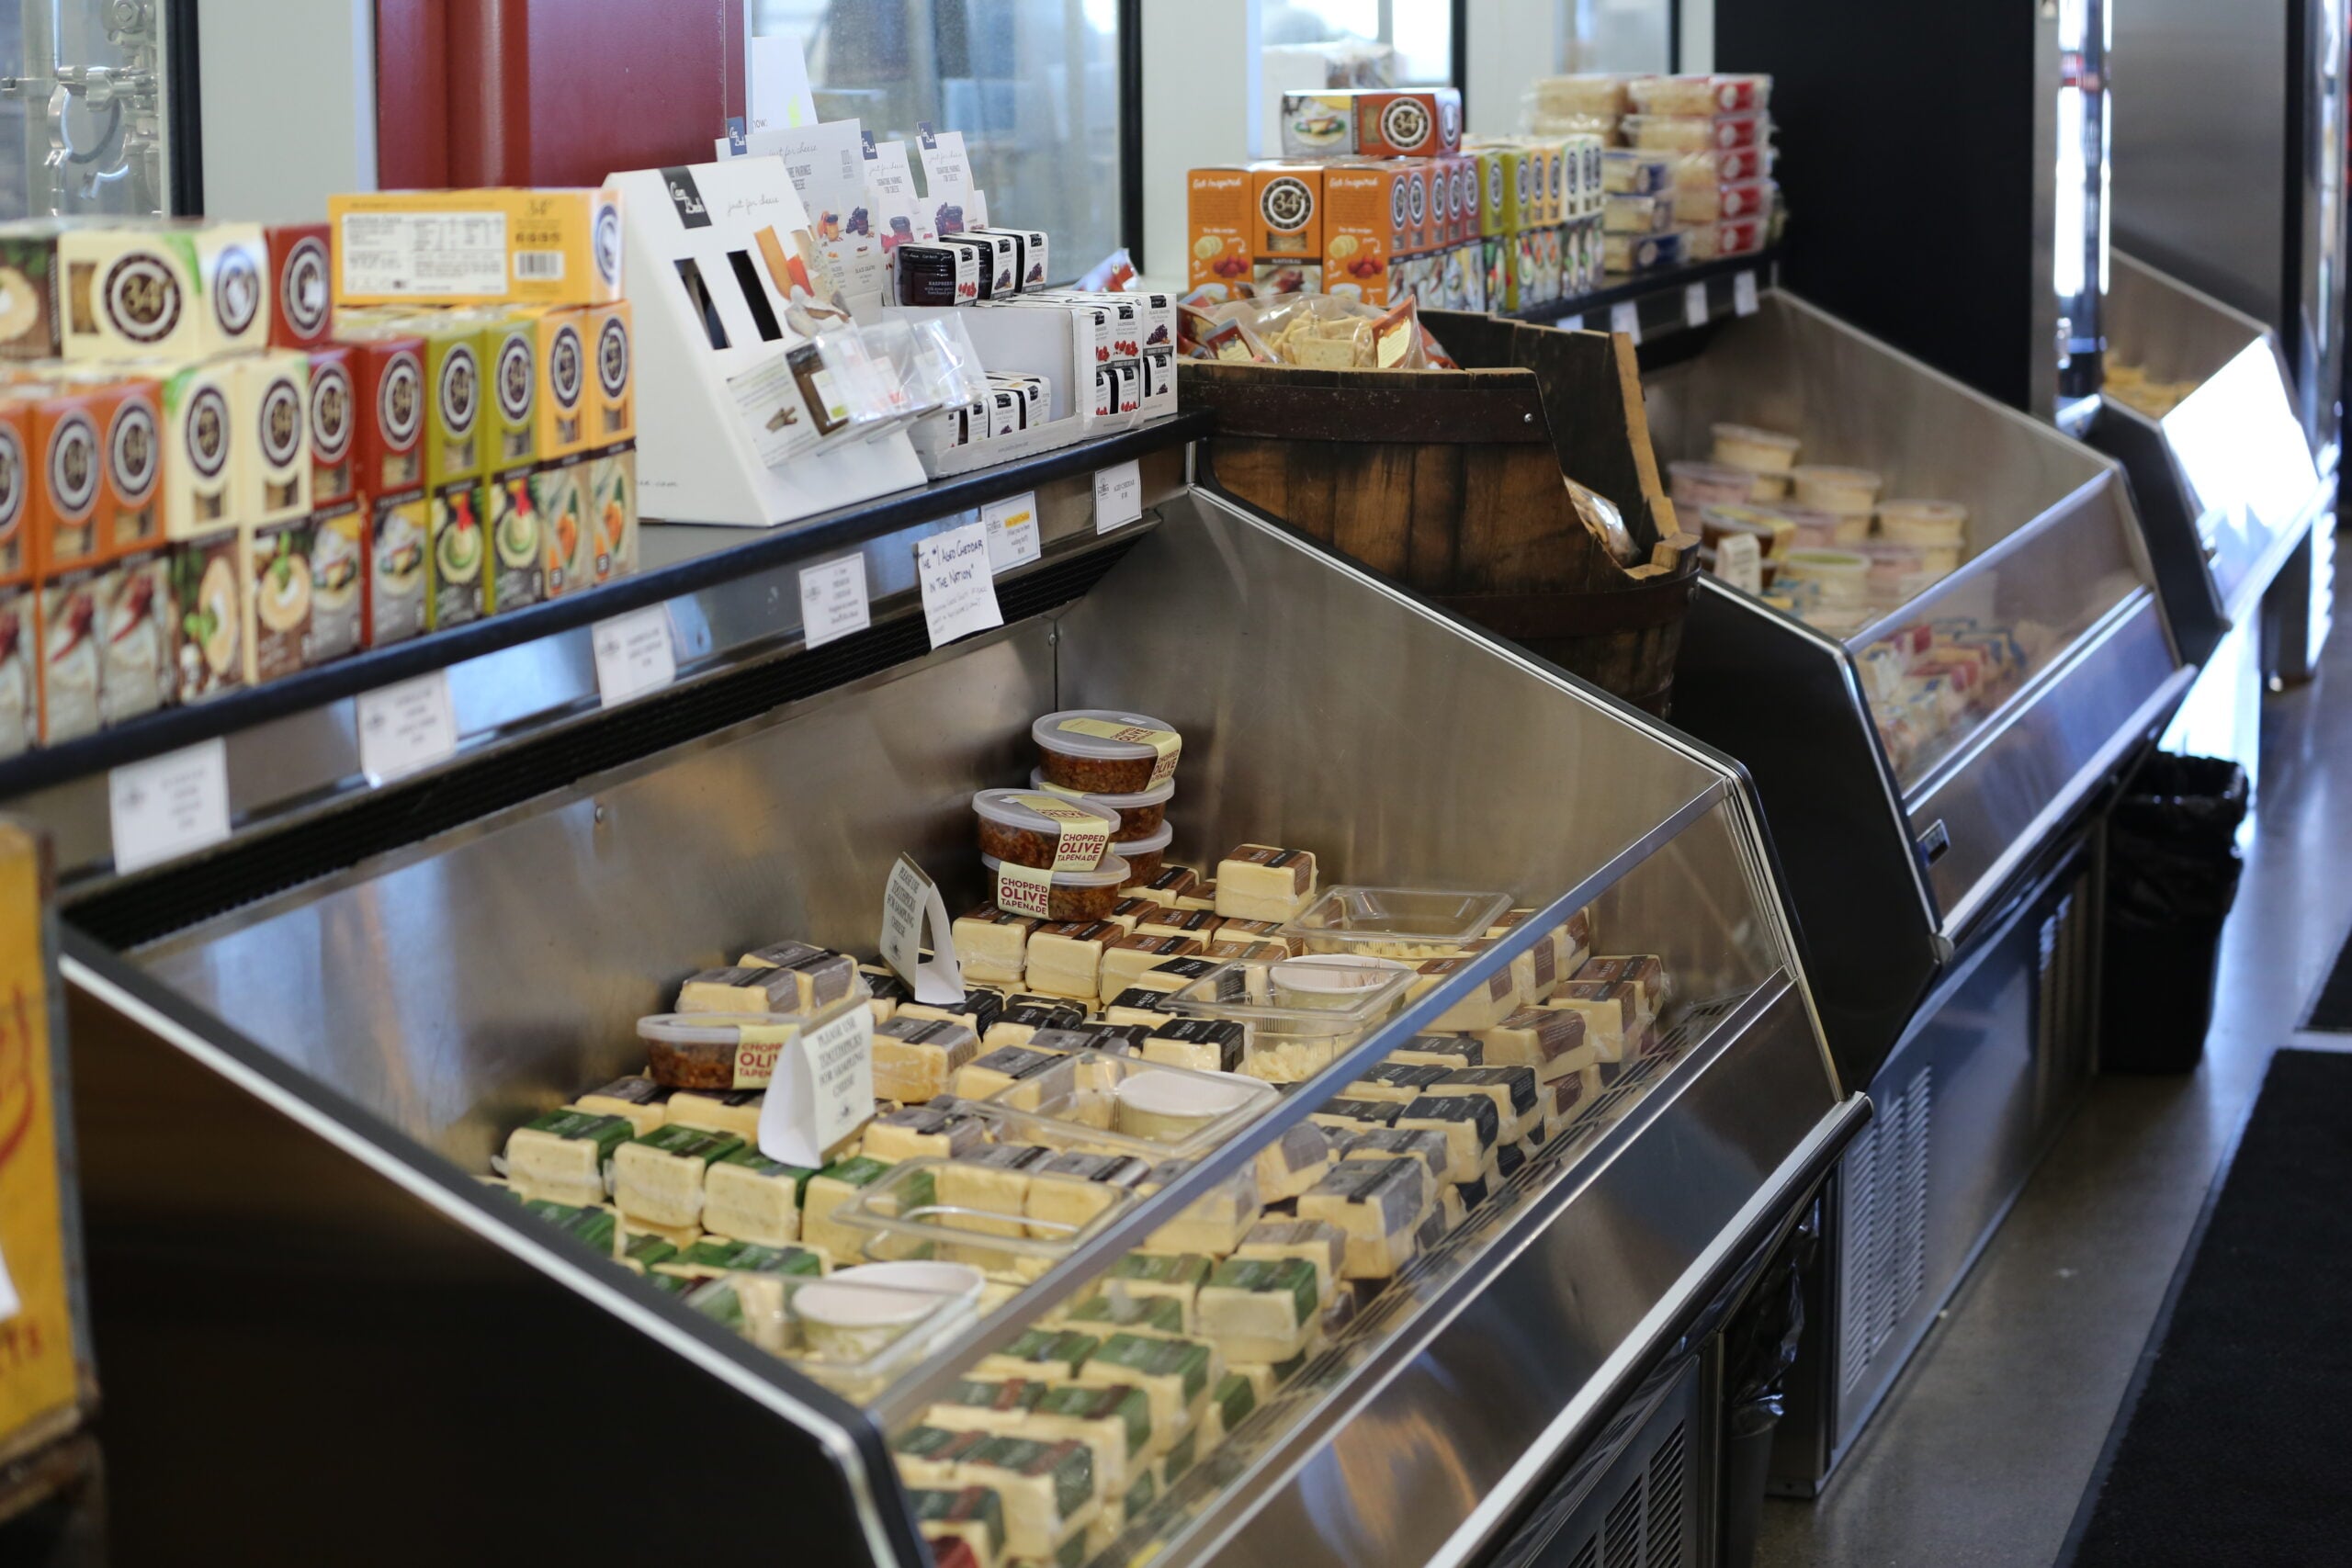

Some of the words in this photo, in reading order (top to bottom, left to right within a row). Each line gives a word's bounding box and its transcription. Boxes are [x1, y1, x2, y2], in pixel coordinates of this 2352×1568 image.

[1273, 192, 1306, 213] 34°
[956, 538, 984, 557] CHEDDAR
[936, 576, 949, 590] THE
[1062, 833, 1106, 843] CHOPPED
[1059, 842, 1103, 854] OLIVE
[1001, 877, 1048, 893] CHOPPED
[1001, 886, 1048, 907] OLIVE
[1001, 898, 1047, 915] TAPENADE
